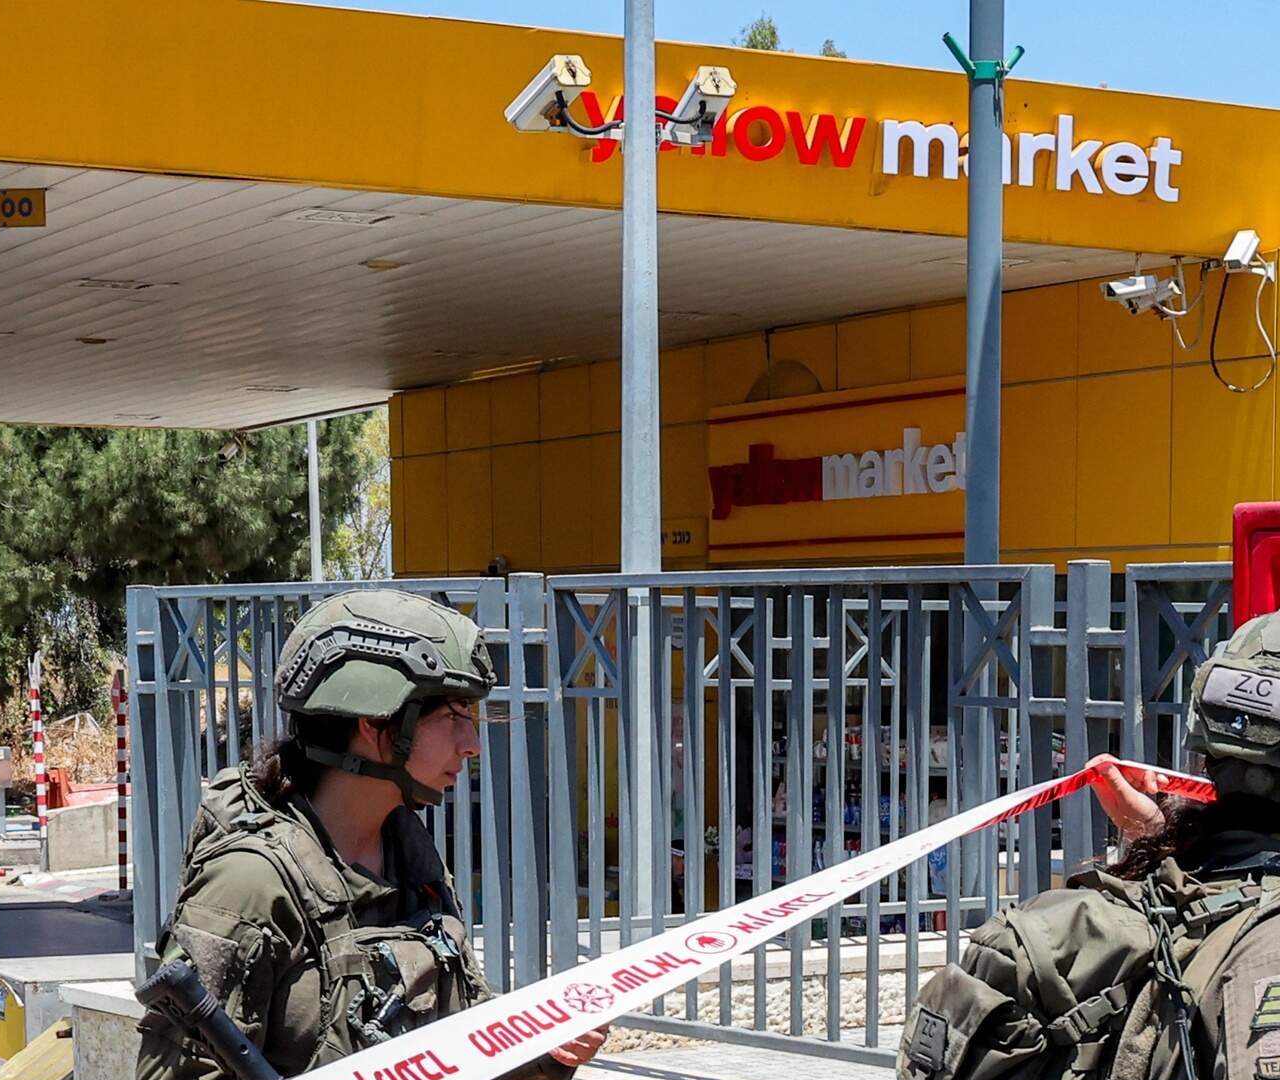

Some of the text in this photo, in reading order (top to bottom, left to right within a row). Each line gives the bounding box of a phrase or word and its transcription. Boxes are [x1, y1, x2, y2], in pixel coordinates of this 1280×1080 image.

[1234, 674, 1274, 698] Z.C
[469, 952, 702, 1056] משטרת ישראל
